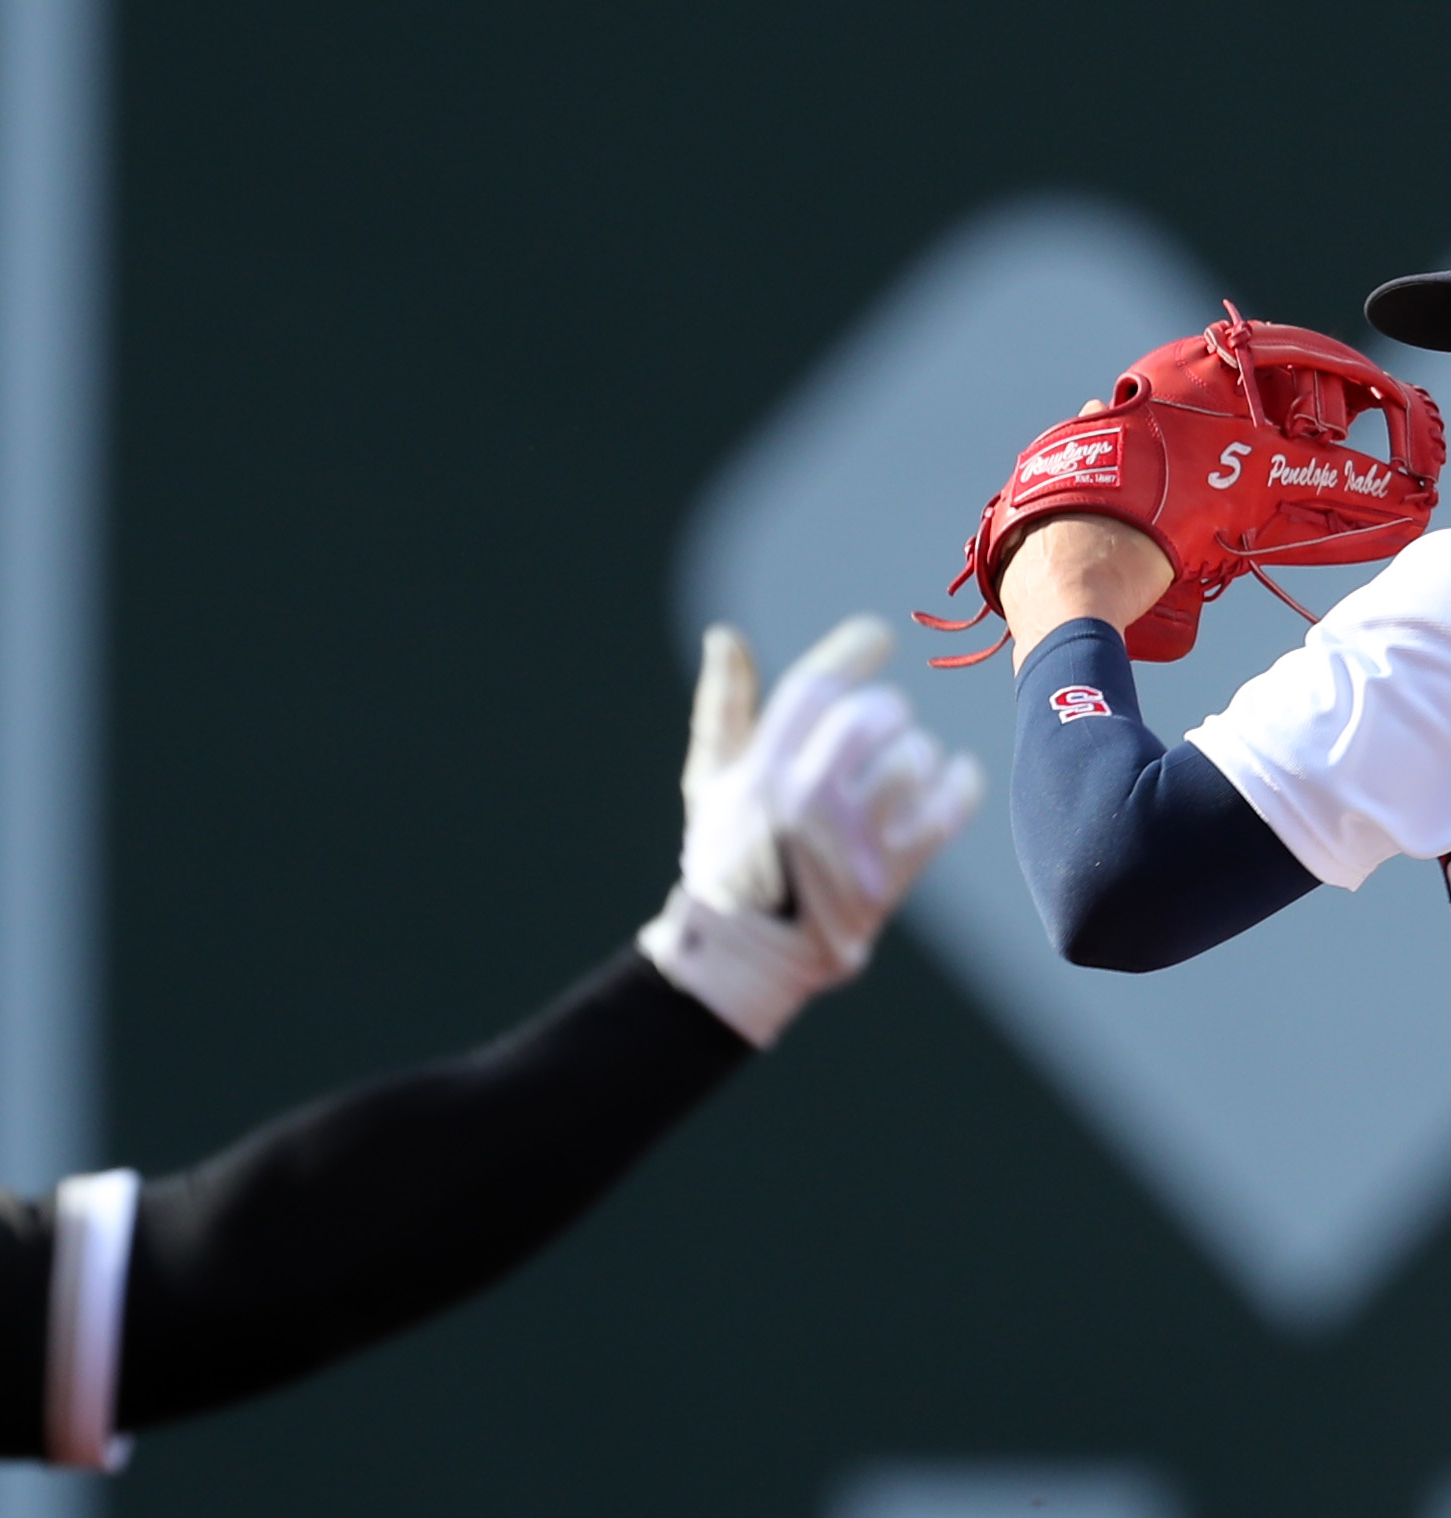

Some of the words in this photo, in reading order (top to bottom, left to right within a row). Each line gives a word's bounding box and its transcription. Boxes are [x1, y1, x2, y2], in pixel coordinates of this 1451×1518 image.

[1020, 441, 1113, 483] Rawlings
[1207, 441, 1252, 489] 5
[1267, 453, 1338, 495] Penelope
[1344, 459, 1392, 498] Isabel
